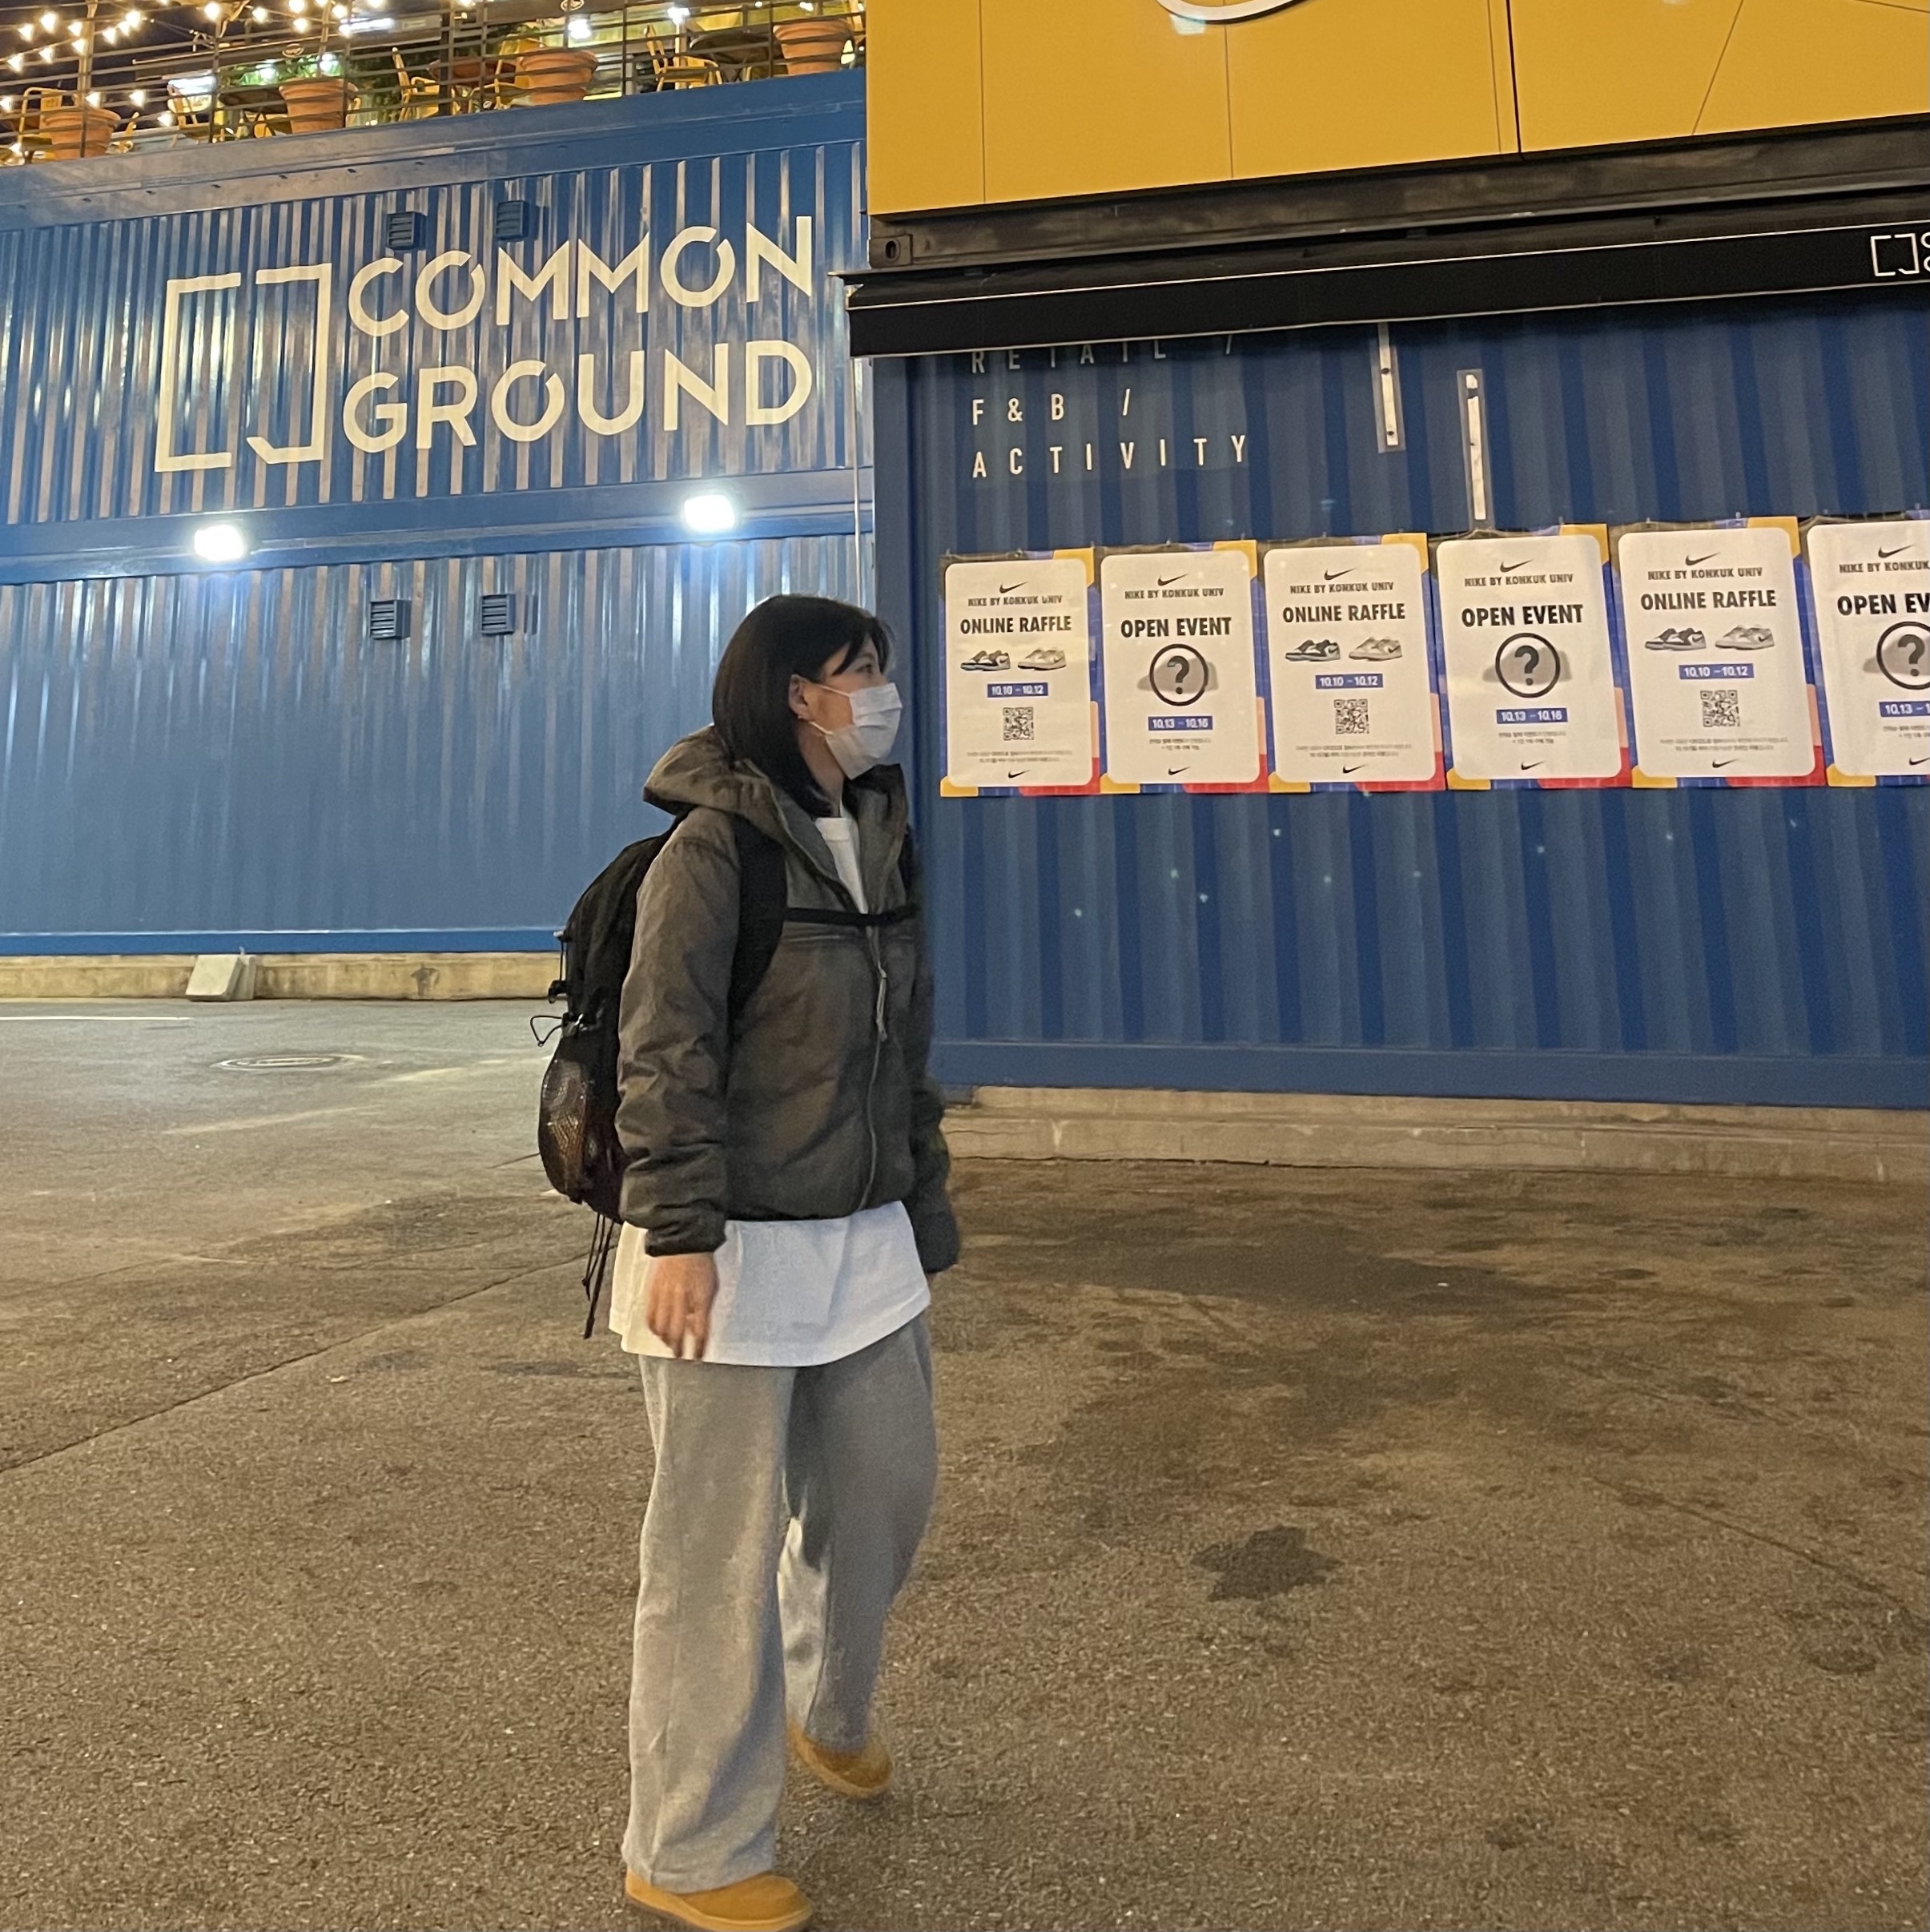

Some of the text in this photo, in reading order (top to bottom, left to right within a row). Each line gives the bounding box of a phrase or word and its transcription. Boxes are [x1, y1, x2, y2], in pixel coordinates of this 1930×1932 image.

[348, 215, 812, 336] COMMON
[343, 340, 813, 453] GROUND
[972, 435, 1245, 478] ACTIVITY
[1647, 570, 1671, 580] NIKE
[1674, 570, 1687, 579] BY
[1737, 567, 1763, 577] UNIV
[1839, 563, 1864, 574] NIKE
[1867, 562, 1880, 573] BY
[1289, 585, 1311, 594] NIKE
[1313, 584, 1326, 594] BY
[1371, 582, 1394, 591] UNIV
[1464, 578, 1486, 587] NIKE
[1490, 577, 1502, 586] BY
[1549, 574, 1574, 583] UNIV
[990, 597, 1000, 606] BY
[1124, 590, 1144, 599] NIKE
[1148, 590, 1160, 598] BY
[1202, 587, 1224, 597] UNIV
[1641, 590, 1776, 610] ONLINE RAFFLE
[1283, 603, 1405, 623] ONLINE RAFFLE
[1837, 594, 1897, 616] OPEN
[960, 615, 1072, 634] ONLINE RAFFLE
[1462, 604, 1583, 627] OPEN EVENT
[1120, 617, 1232, 638] OPEN EVENT
[1514, 645, 1539, 686] ?
[1897, 634, 1925, 677] ?
[1167, 655, 1190, 694] ?
